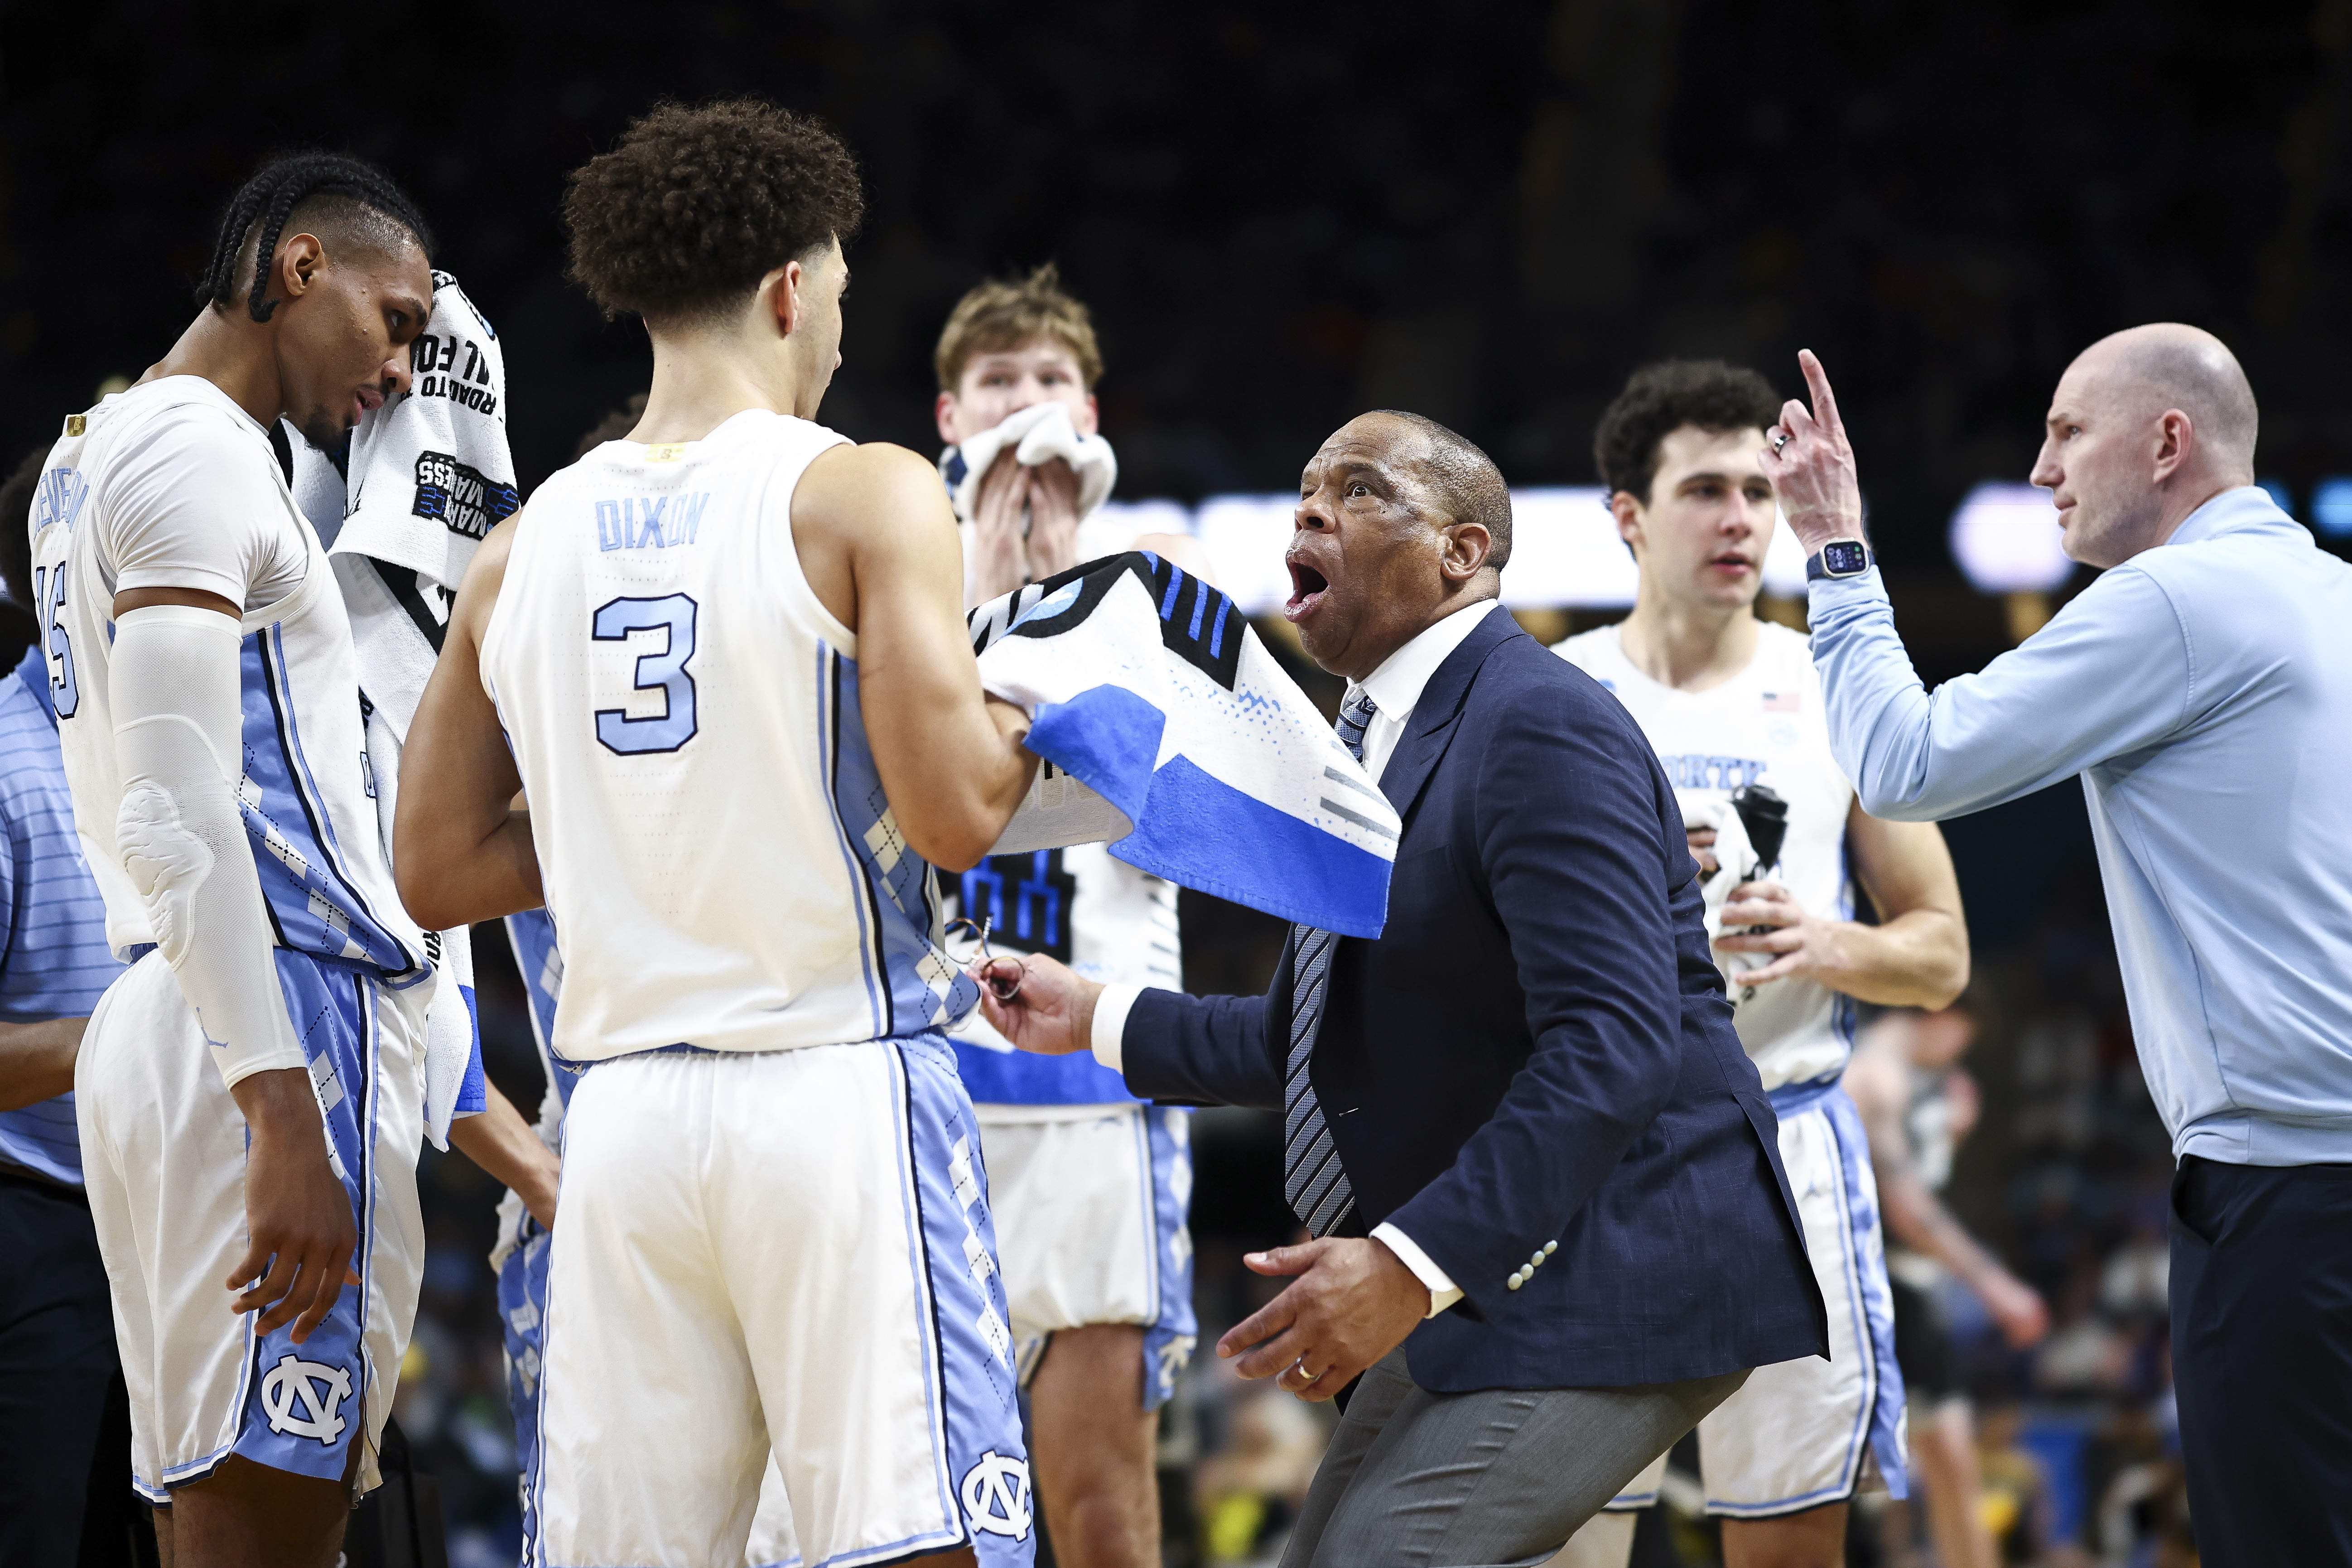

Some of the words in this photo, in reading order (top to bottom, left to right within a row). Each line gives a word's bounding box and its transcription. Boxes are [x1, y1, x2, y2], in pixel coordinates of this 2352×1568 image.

[410, 334, 457, 374] FO
[421, 376, 447, 398] TO
[595, 491, 710, 552] DIXON
[592, 591, 698, 756] 3
